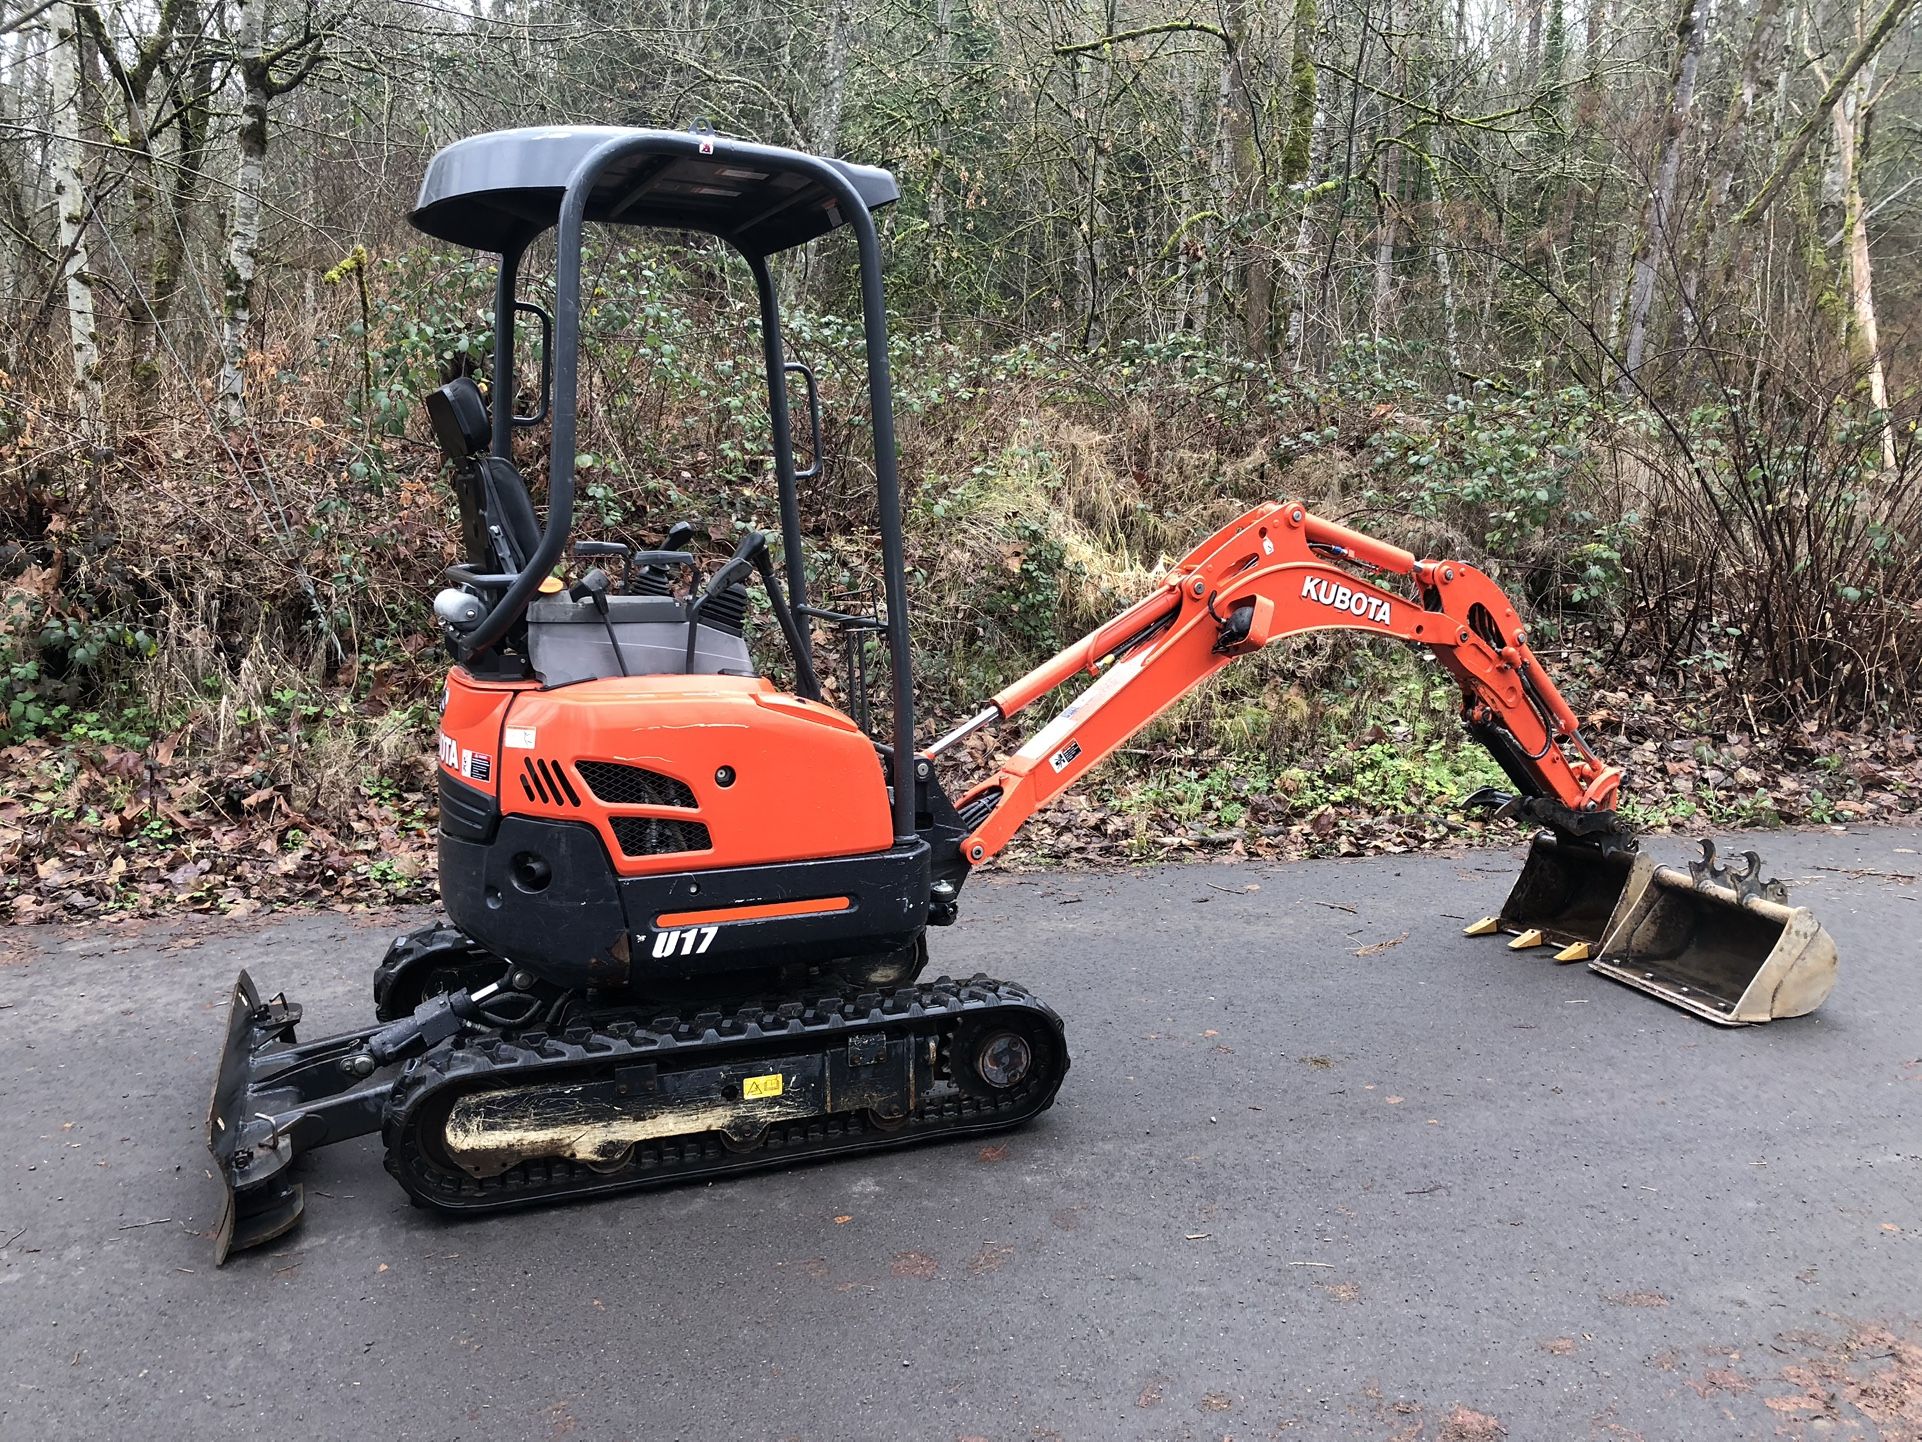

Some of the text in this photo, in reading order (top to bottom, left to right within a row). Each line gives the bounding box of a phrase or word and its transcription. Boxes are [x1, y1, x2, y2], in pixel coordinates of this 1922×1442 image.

[1301, 575, 1392, 626] KUBOTA
[439, 732, 460, 771] OTA
[651, 926, 719, 959] U17
